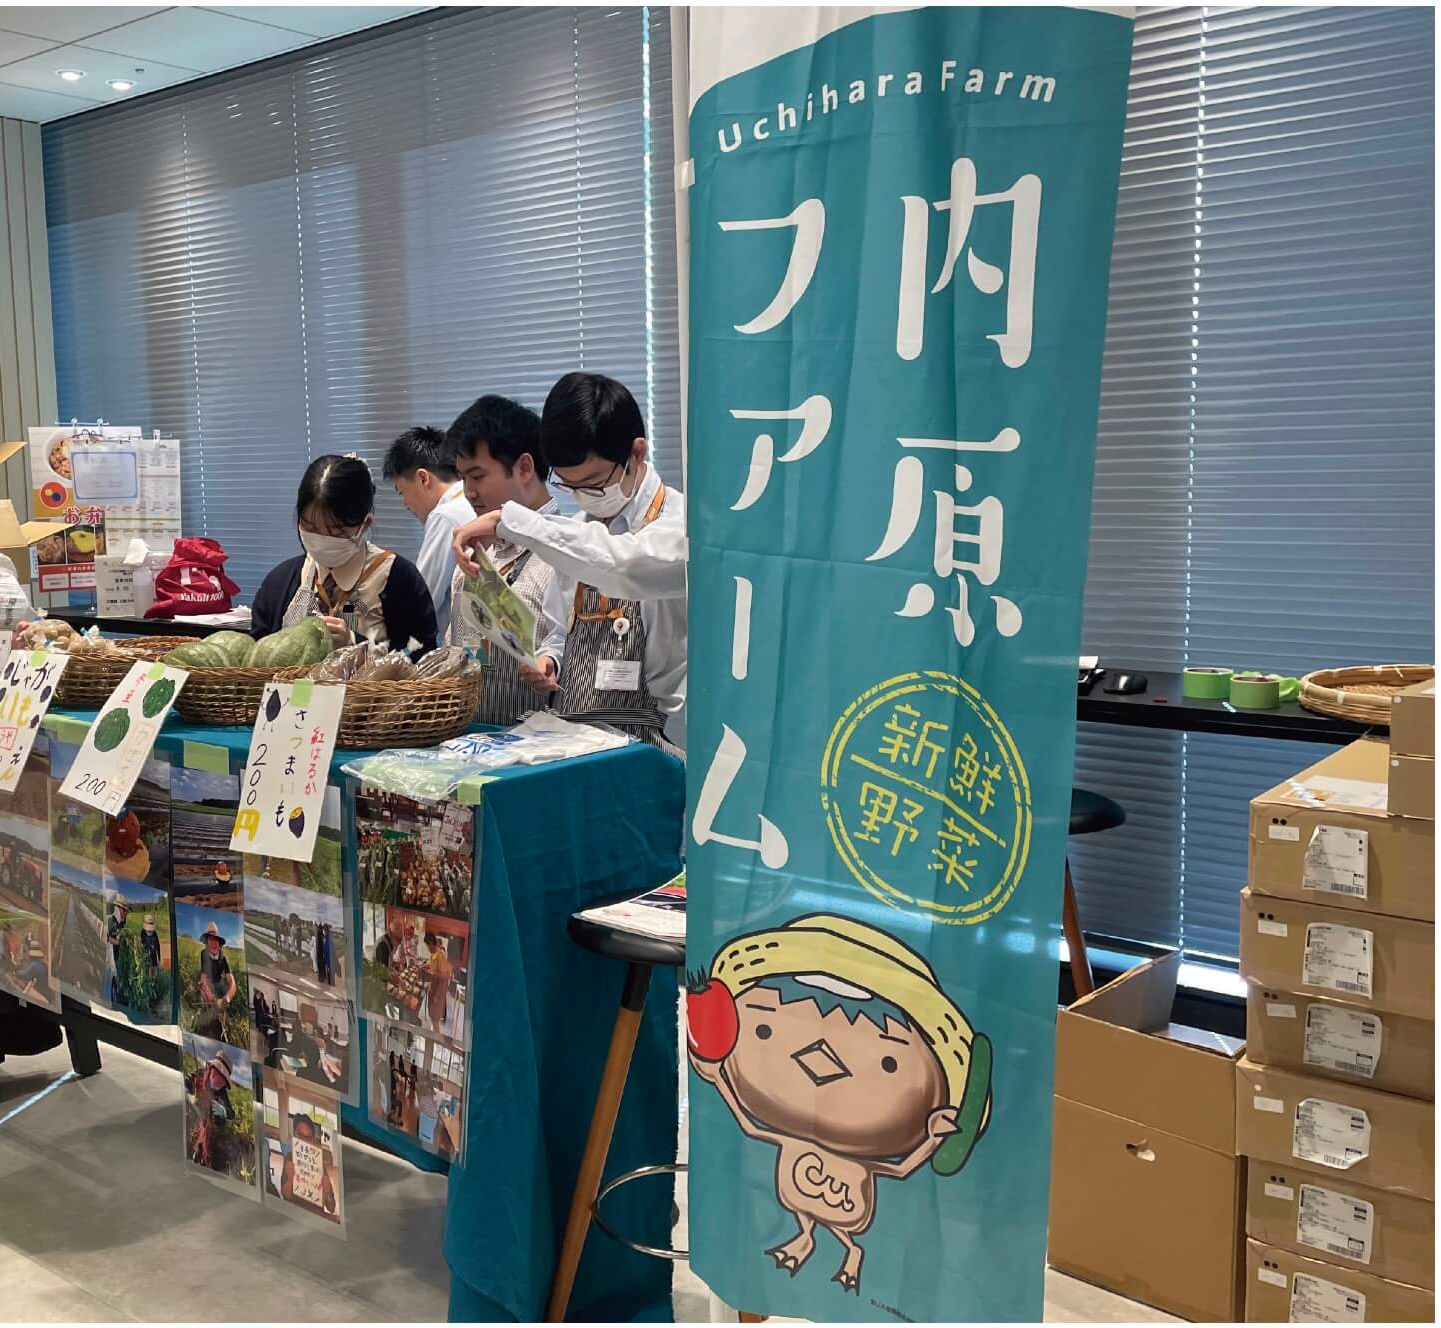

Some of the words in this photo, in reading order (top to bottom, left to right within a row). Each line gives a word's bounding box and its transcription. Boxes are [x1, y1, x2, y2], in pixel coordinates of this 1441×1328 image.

[717, 70, 923, 154] Uchihara
[941, 60, 1057, 103] Farm
[864, 157, 1044, 648] 内原
[690, 197, 833, 870] ファーム
[75, 773, 107, 796] 200
[275, 709, 308, 828] さつまいも
[304, 726, 326, 797] 紅はるか
